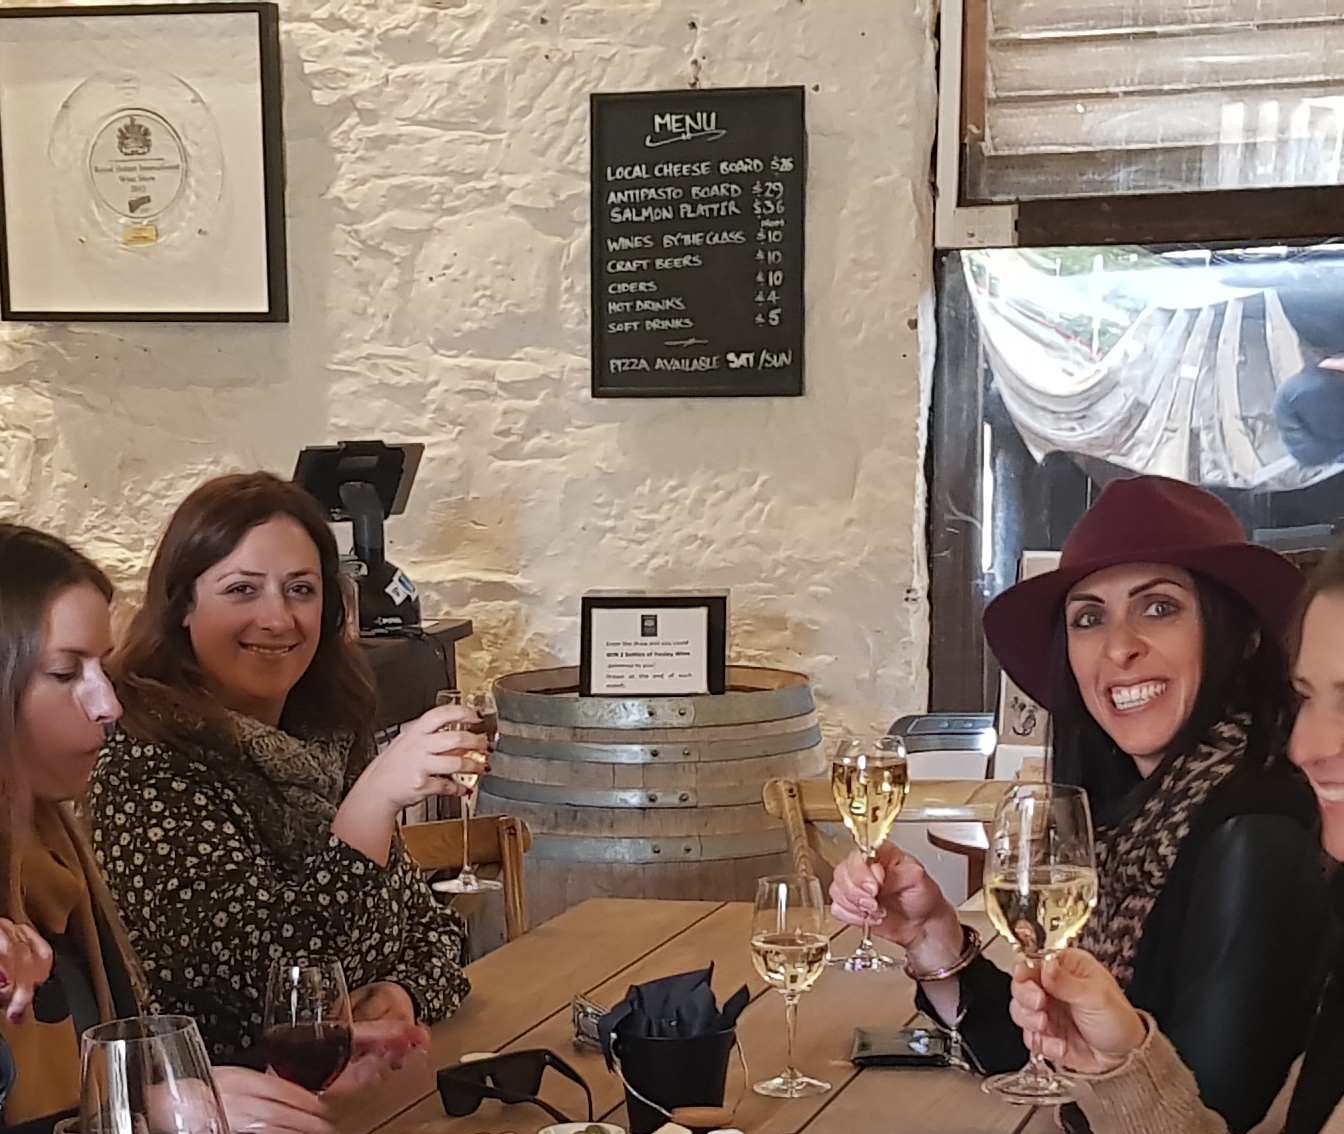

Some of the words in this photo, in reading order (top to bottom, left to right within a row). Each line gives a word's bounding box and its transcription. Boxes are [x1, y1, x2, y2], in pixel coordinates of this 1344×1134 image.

[654, 112, 716, 133] MENU
[607, 165, 650, 181] LOCAL
[654, 161, 711, 178] CHEESE
[720, 159, 763, 174] BOARD
[607, 187, 683, 204] ANTIPASTO
[691, 184, 742, 200] BOARD
[610, 205, 673, 222] SALMON
[680, 201, 741, 218] PLATTER
[607, 234, 654, 251] WINES
[706, 231, 746, 245] GLASS
[607, 260, 649, 272] CRAFT
[655, 255, 702, 270] BEERS
[608, 281, 657, 294] CIDERS
[608, 302, 632, 314] HOT
[635, 297, 686, 312] DRINKS
[608, 321, 640, 333] SOFT
[645, 317, 694, 330] DRINKS
[610, 354, 650, 373] PIZZA
[655, 355, 720, 372] AVAILABLE
